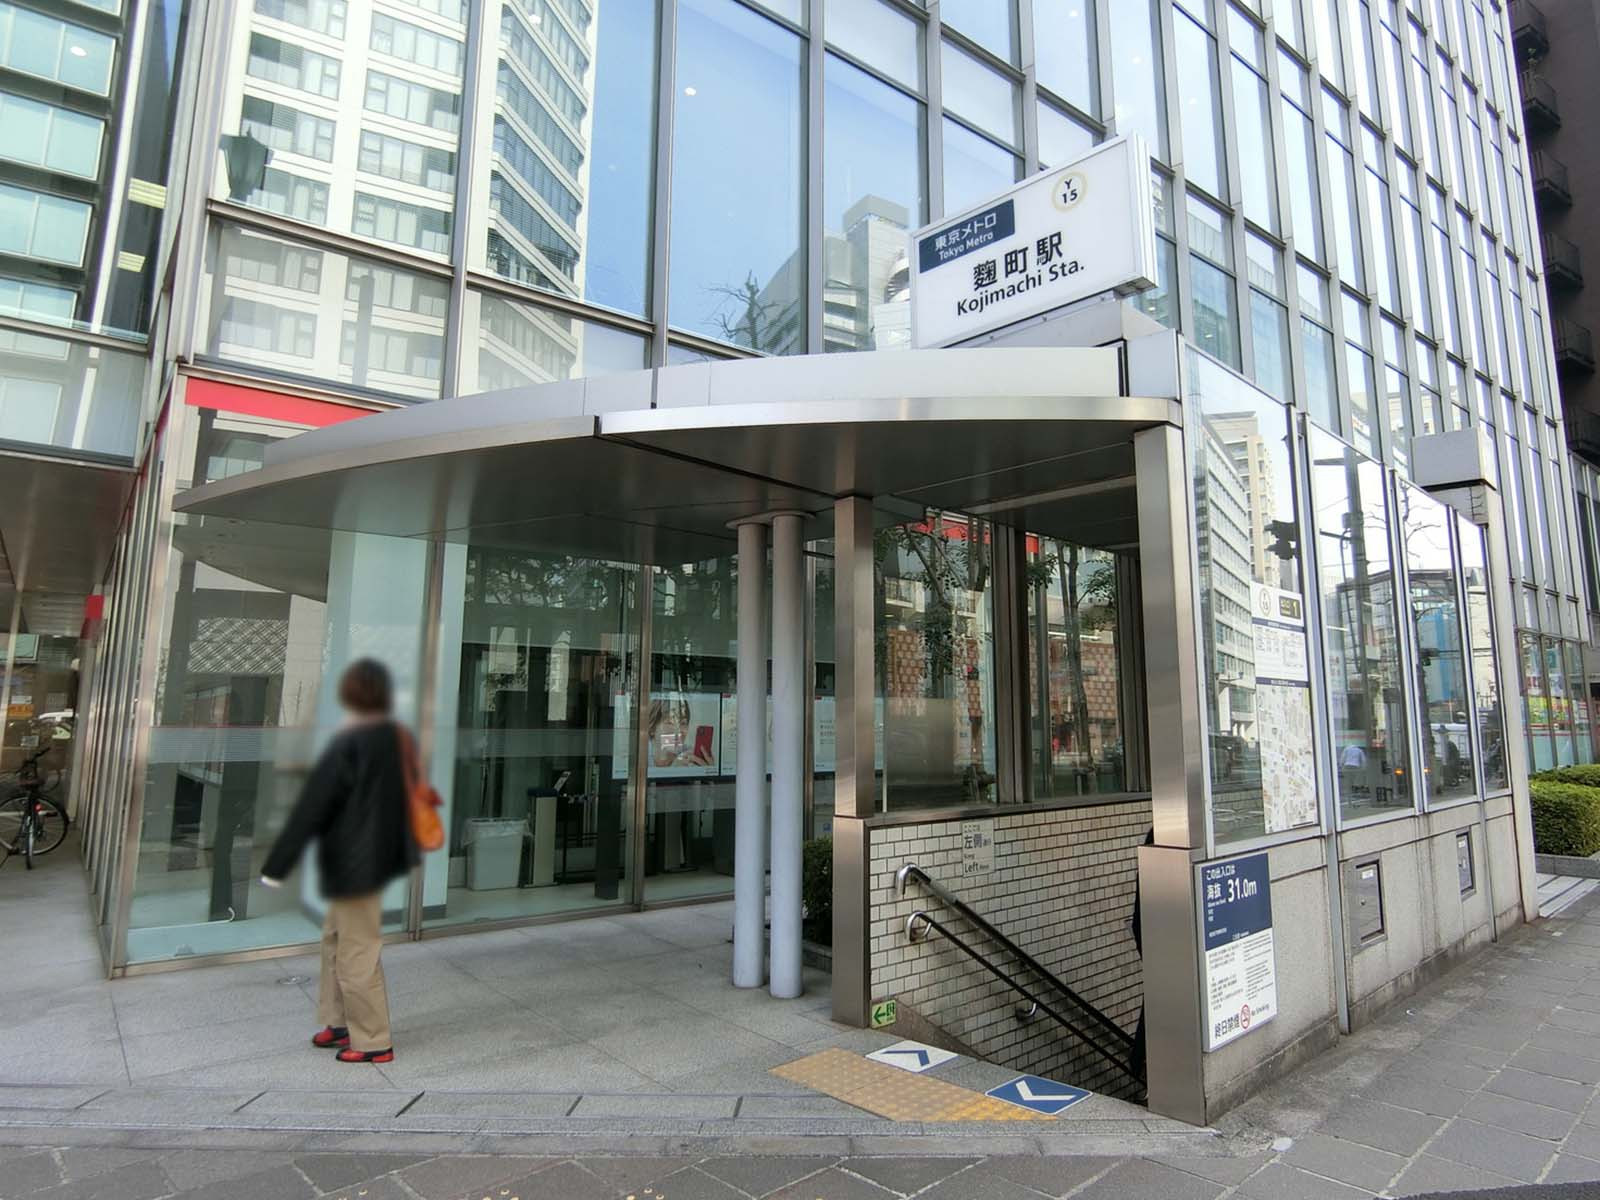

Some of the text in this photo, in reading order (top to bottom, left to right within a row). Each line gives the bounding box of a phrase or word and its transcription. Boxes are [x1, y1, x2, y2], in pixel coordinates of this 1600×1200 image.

[1064, 178, 1073, 189] Y
[1062, 189, 1078, 204] 15
[935, 212, 997, 251] 東京メトロ
[938, 231, 994, 262] Tokyo Metro
[957, 259, 1085, 316] Kojimachi Sta.
[1292, 600, 1298, 617] 1
[965, 861, 978, 873] Left
[1227, 878, 1257, 903] 31.0m
